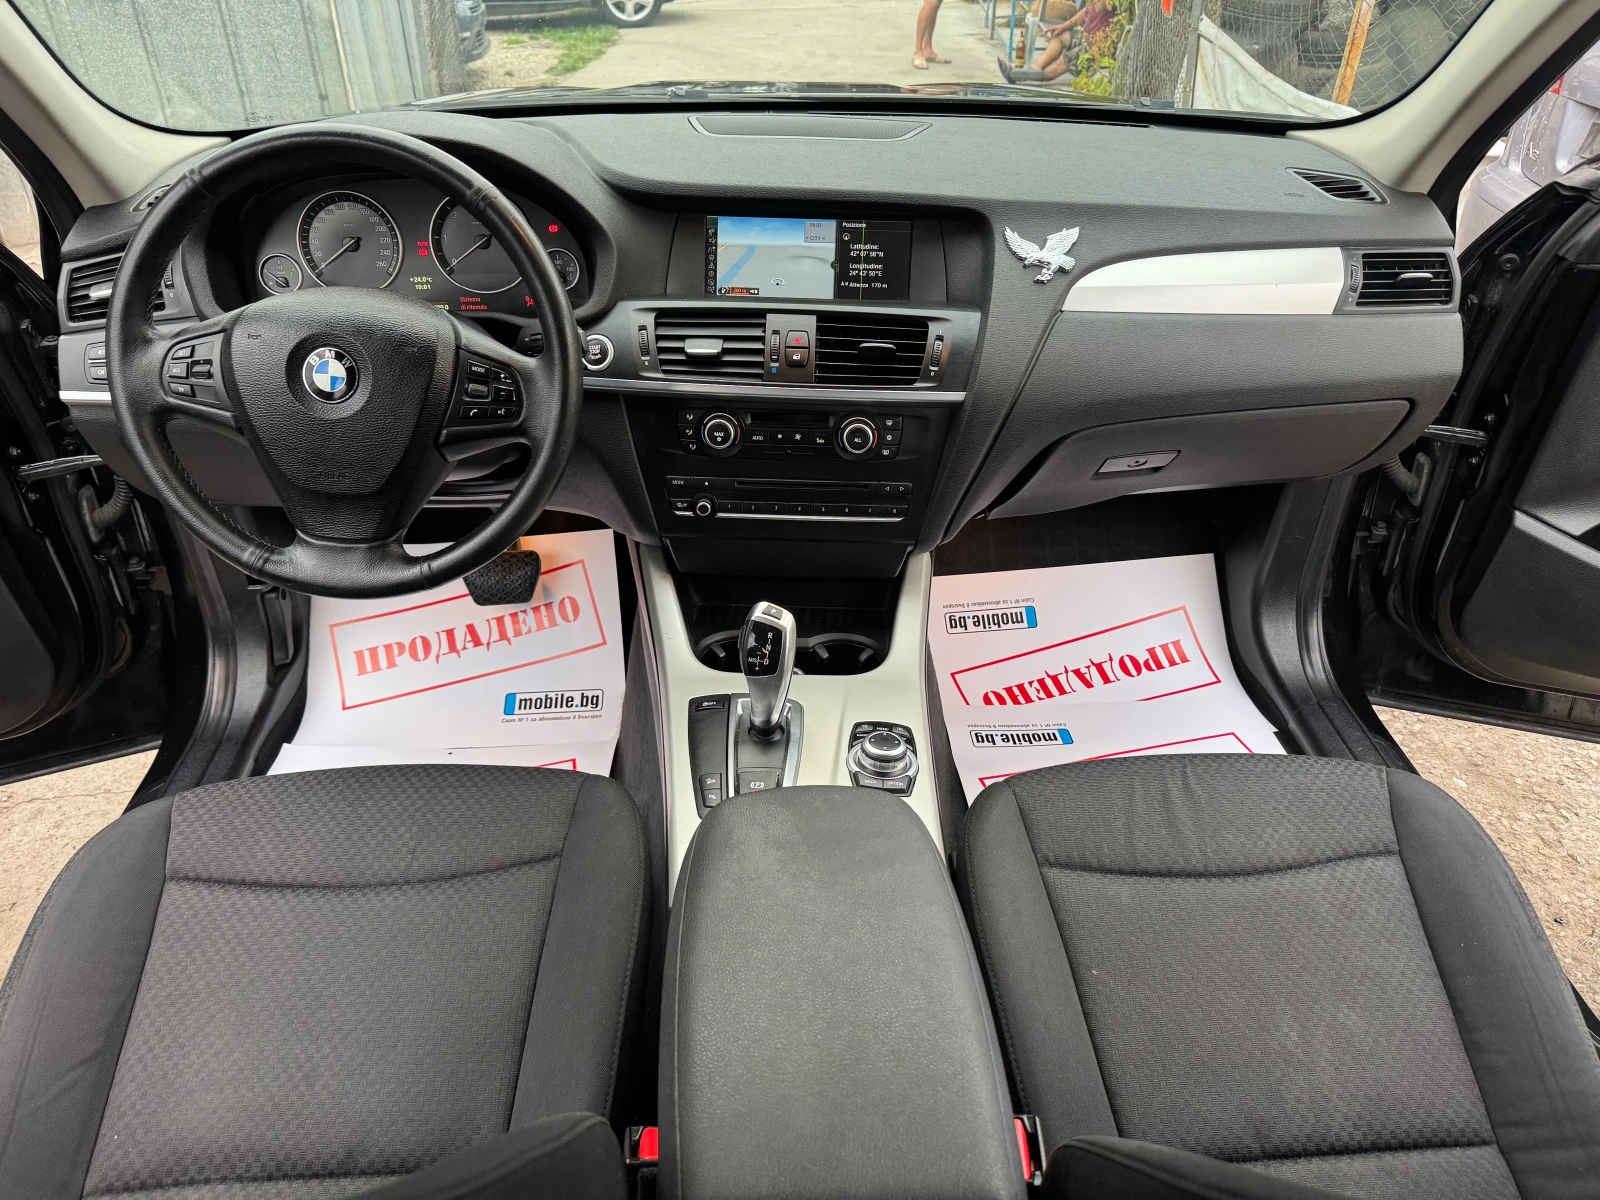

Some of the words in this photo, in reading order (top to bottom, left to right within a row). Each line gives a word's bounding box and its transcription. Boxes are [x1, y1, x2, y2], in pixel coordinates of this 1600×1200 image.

[849, 262, 884, 270] Longitudine:
[308, 349, 353, 369] BMW
[948, 611, 1025, 631] mobile.bg
[353, 595, 581, 677] ПРОДАДЕНО
[982, 639, 1191, 706] ПРОДАДЕНО
[518, 692, 600, 711] mobile.bg
[974, 732, 1059, 746] mobile.bg
